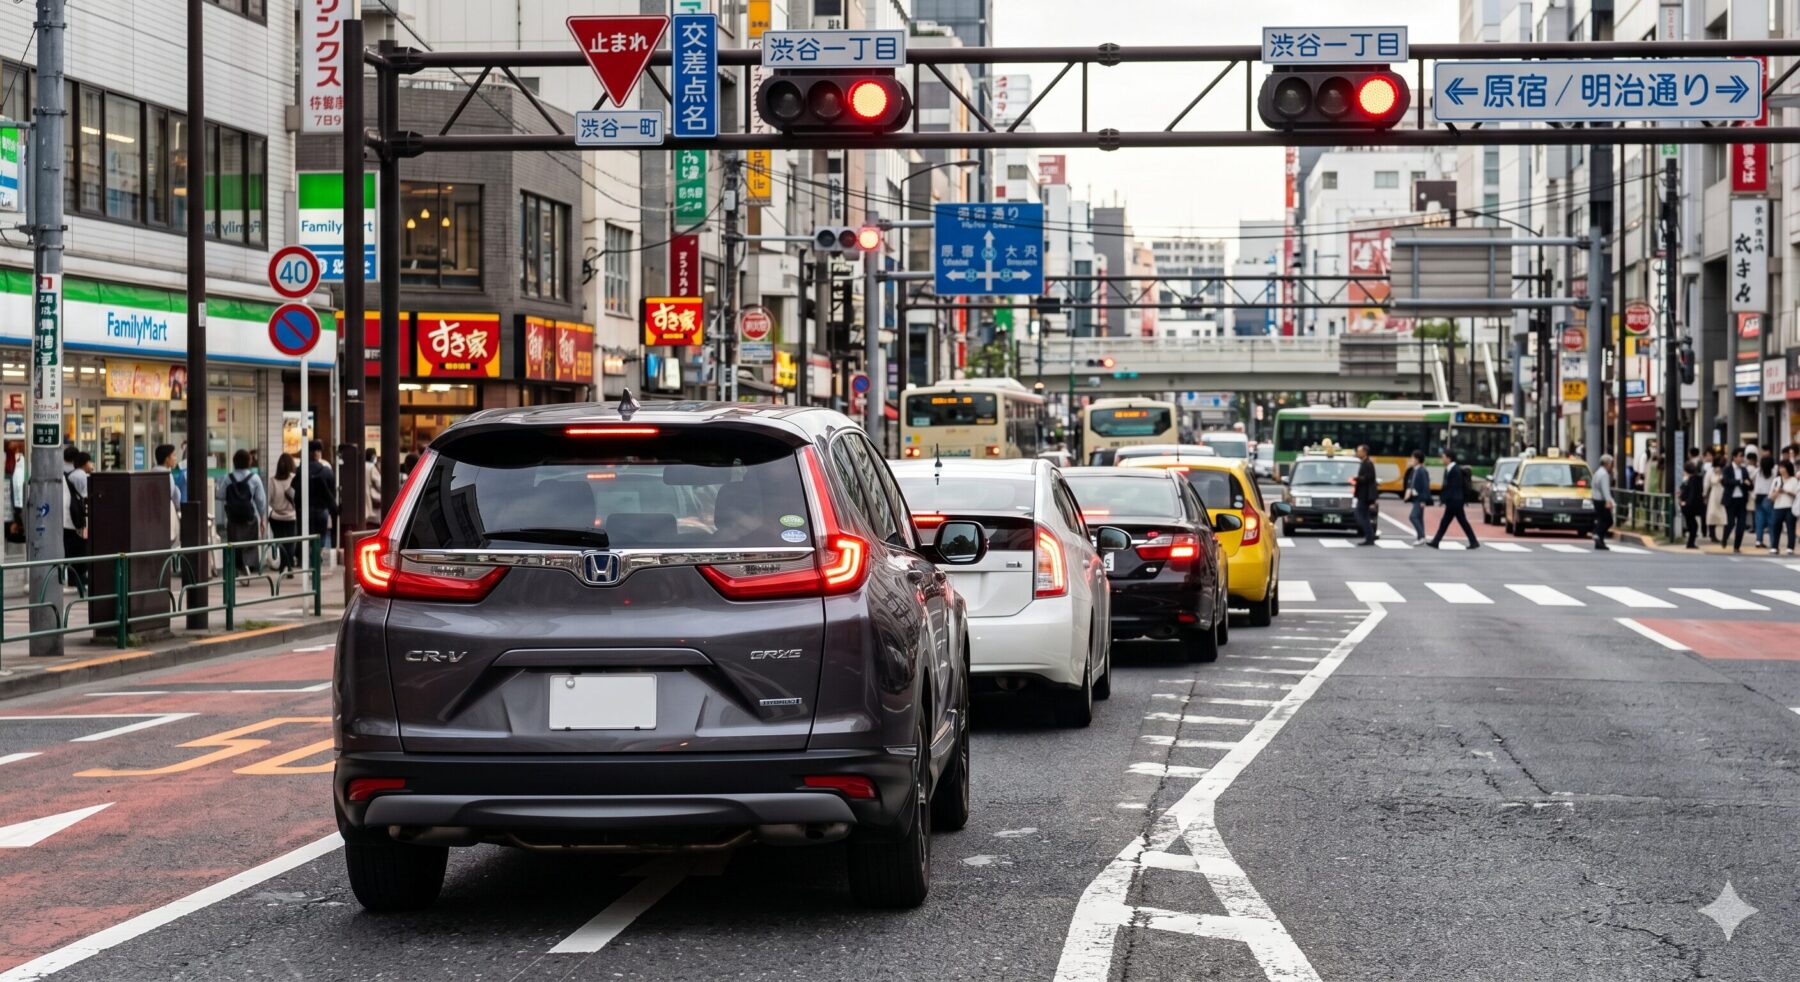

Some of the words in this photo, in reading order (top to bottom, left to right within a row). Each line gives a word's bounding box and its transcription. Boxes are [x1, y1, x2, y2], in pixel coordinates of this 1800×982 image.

[589, 32, 649, 53] 止まれ
[770, 37, 897, 61] 渋谷一丁目
[1270, 33, 1399, 57] 渋谷一丁目
[682, 22, 707, 131] 交差点名
[1483, 74, 1548, 108] 原宿
[1581, 73, 1709, 108] 明治通り
[581, 118, 658, 138] 渋谷一町
[301, 219, 374, 235] Familyrt
[279, 261, 309, 284] 40
[107, 311, 168, 346] FamilyMart
[651, 302, 696, 332] すき家
[428, 319, 488, 359] すき家
[405, 650, 468, 662] CR-V
